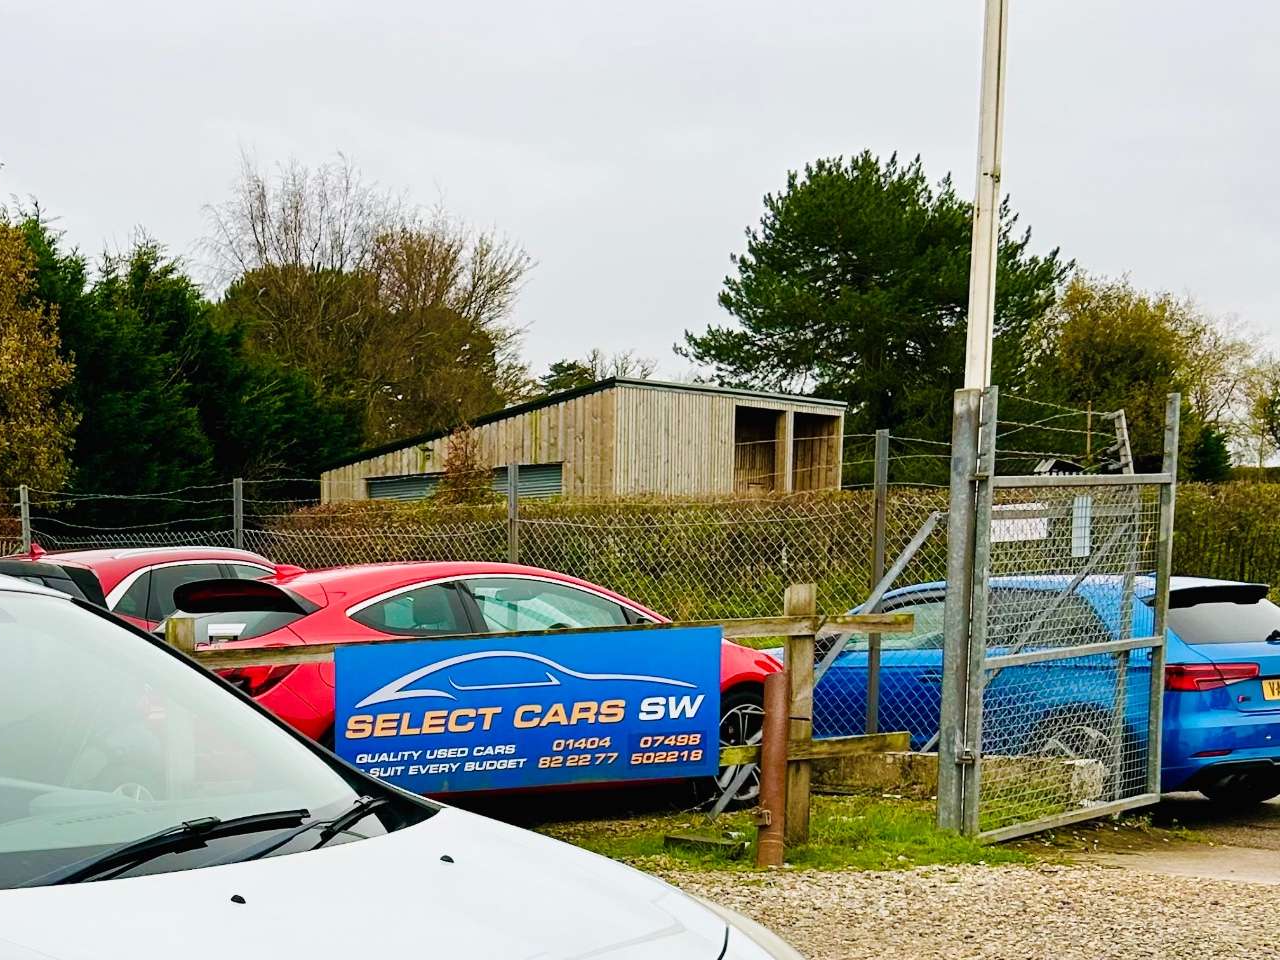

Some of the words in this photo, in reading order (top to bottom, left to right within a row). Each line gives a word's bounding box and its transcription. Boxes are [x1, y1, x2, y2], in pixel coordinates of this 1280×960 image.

[345, 706, 502, 739] SELECT
[513, 699, 626, 729] CARS
[638, 694, 705, 722] SW
[552, 736, 611, 752] 01404
[639, 733, 701, 748] 07498
[355, 750, 423, 764] QUALITY
[426, 747, 469, 760] USED
[473, 744, 516, 756] CARS
[631, 750, 703, 765] 502218
[369, 766, 405, 778] SUIT
[408, 762, 462, 776] EVERY
[463, 757, 527, 772] BUDGET
